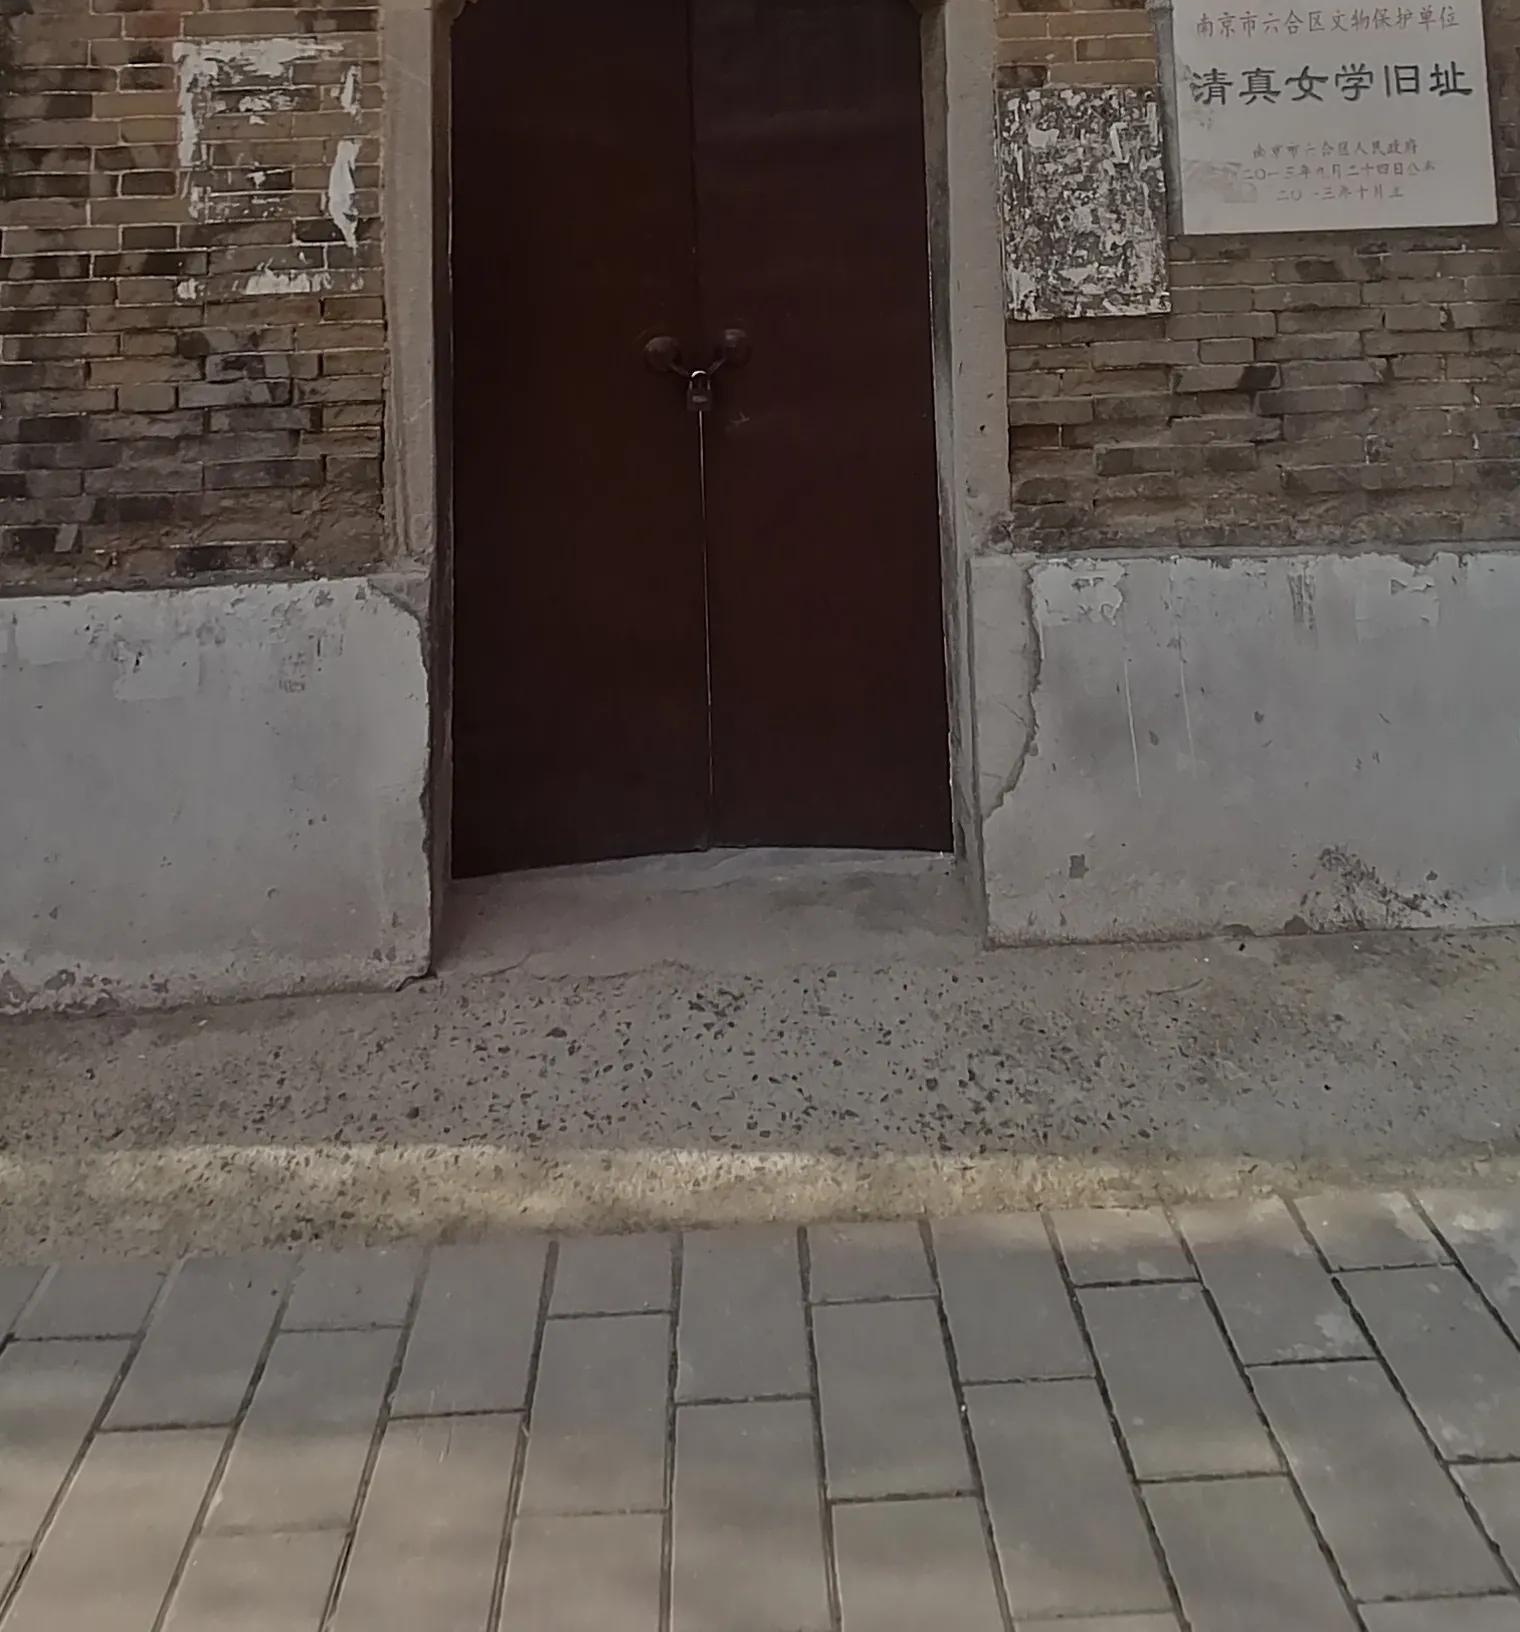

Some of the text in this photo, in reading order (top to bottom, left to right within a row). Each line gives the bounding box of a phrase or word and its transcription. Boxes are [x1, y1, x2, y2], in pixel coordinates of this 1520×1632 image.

[1196, 5, 1460, 39] 南京市六合区文物保护单位
[1192, 61, 1473, 106] 清真女学旧址
